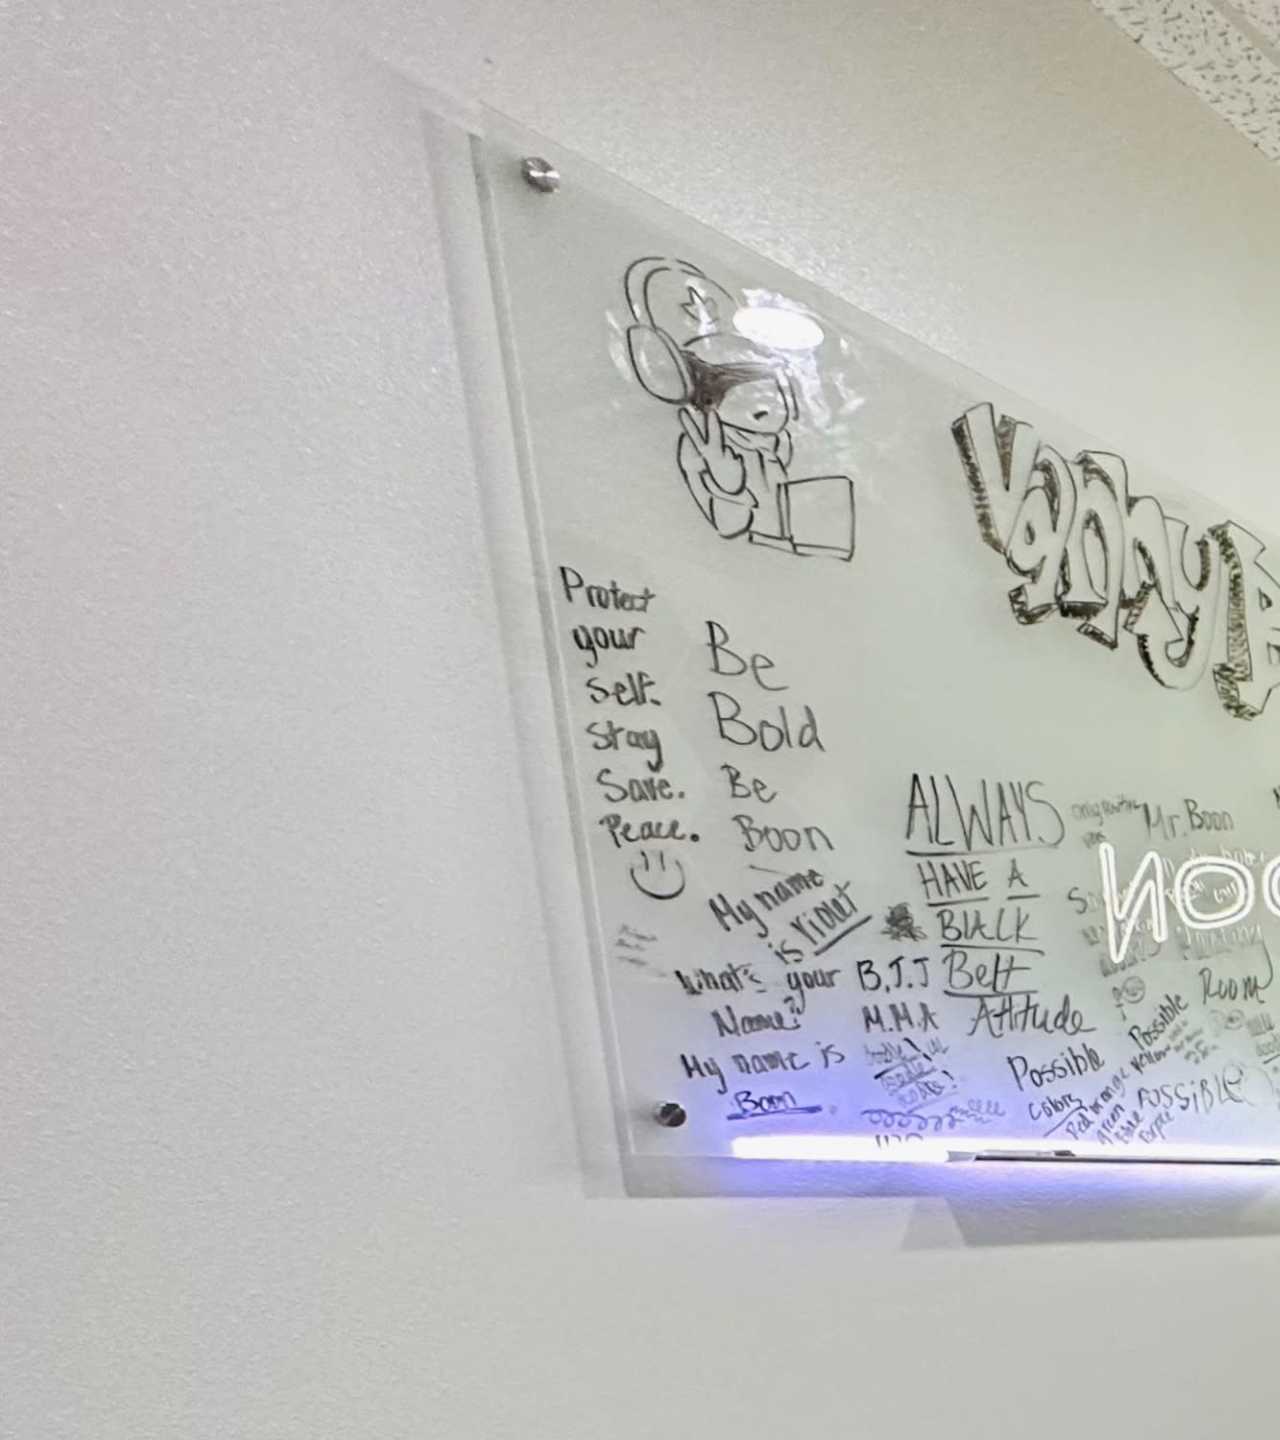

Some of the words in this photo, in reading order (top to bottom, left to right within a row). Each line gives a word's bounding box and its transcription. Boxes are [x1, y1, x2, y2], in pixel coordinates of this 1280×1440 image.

[572, 624, 646, 668] your
[705, 620, 789, 691] Be
[707, 690, 826, 752] Bold
[586, 720, 663, 773] Stay
[720, 763, 777, 803] Be
[732, 814, 835, 852] Boon
[905, 773, 1065, 851] ALWAYS
[1184, 798, 1234, 832] Boon
[709, 893, 769, 938] My
[755, 868, 825, 911] name
[917, 860, 989, 900] HAVE
[1008, 858, 1029, 888] A
[768, 940, 804, 965] is
[942, 947, 1033, 993] Belt
[786, 967, 842, 1015] your
[681, 1054, 728, 1094] My
[733, 1051, 810, 1075] name
[816, 1041, 846, 1069] is
[1007, 1042, 1105, 1092] Possible
